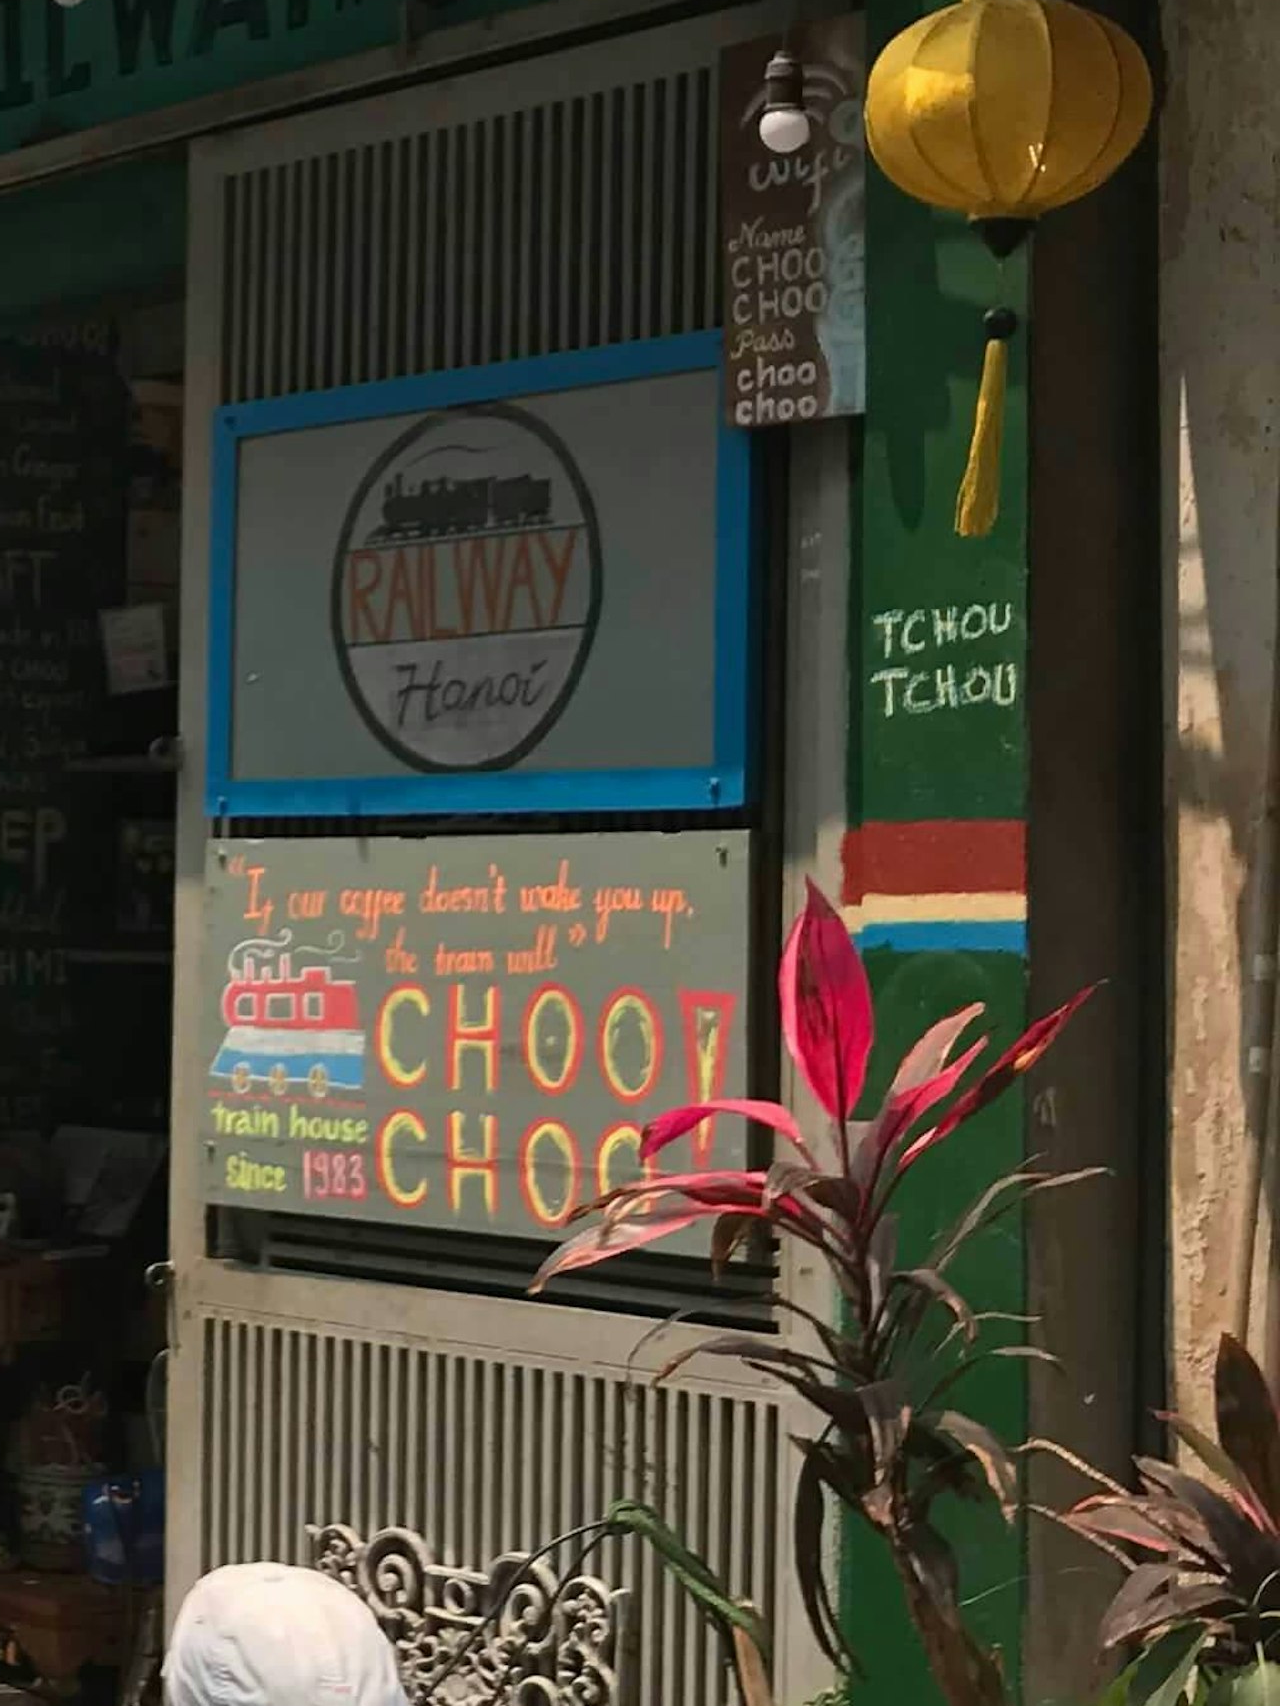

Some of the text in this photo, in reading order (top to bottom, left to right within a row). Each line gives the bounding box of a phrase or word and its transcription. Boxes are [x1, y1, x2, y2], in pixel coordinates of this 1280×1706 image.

[729, 214, 807, 253] Name
[731, 247, 828, 290] CHOO
[732, 281, 829, 325] CHOO
[730, 329, 797, 360] Pass
[349, 528, 578, 646] RAILWAY
[871, 601, 1013, 660] TCHOU
[395, 659, 548, 728] Hanoi
[869, 662, 1017, 719] TCHOU
[286, 889, 327, 920] our
[340, 888, 407, 940] coffee
[419, 862, 508, 916] doesn't
[520, 858, 583, 914] wake
[593, 888, 643, 944] you
[385, 927, 418, 975] the
[434, 938, 495, 976] train
[210, 1102, 369, 1146] train house
[225, 1148, 369, 1202] since 1983
